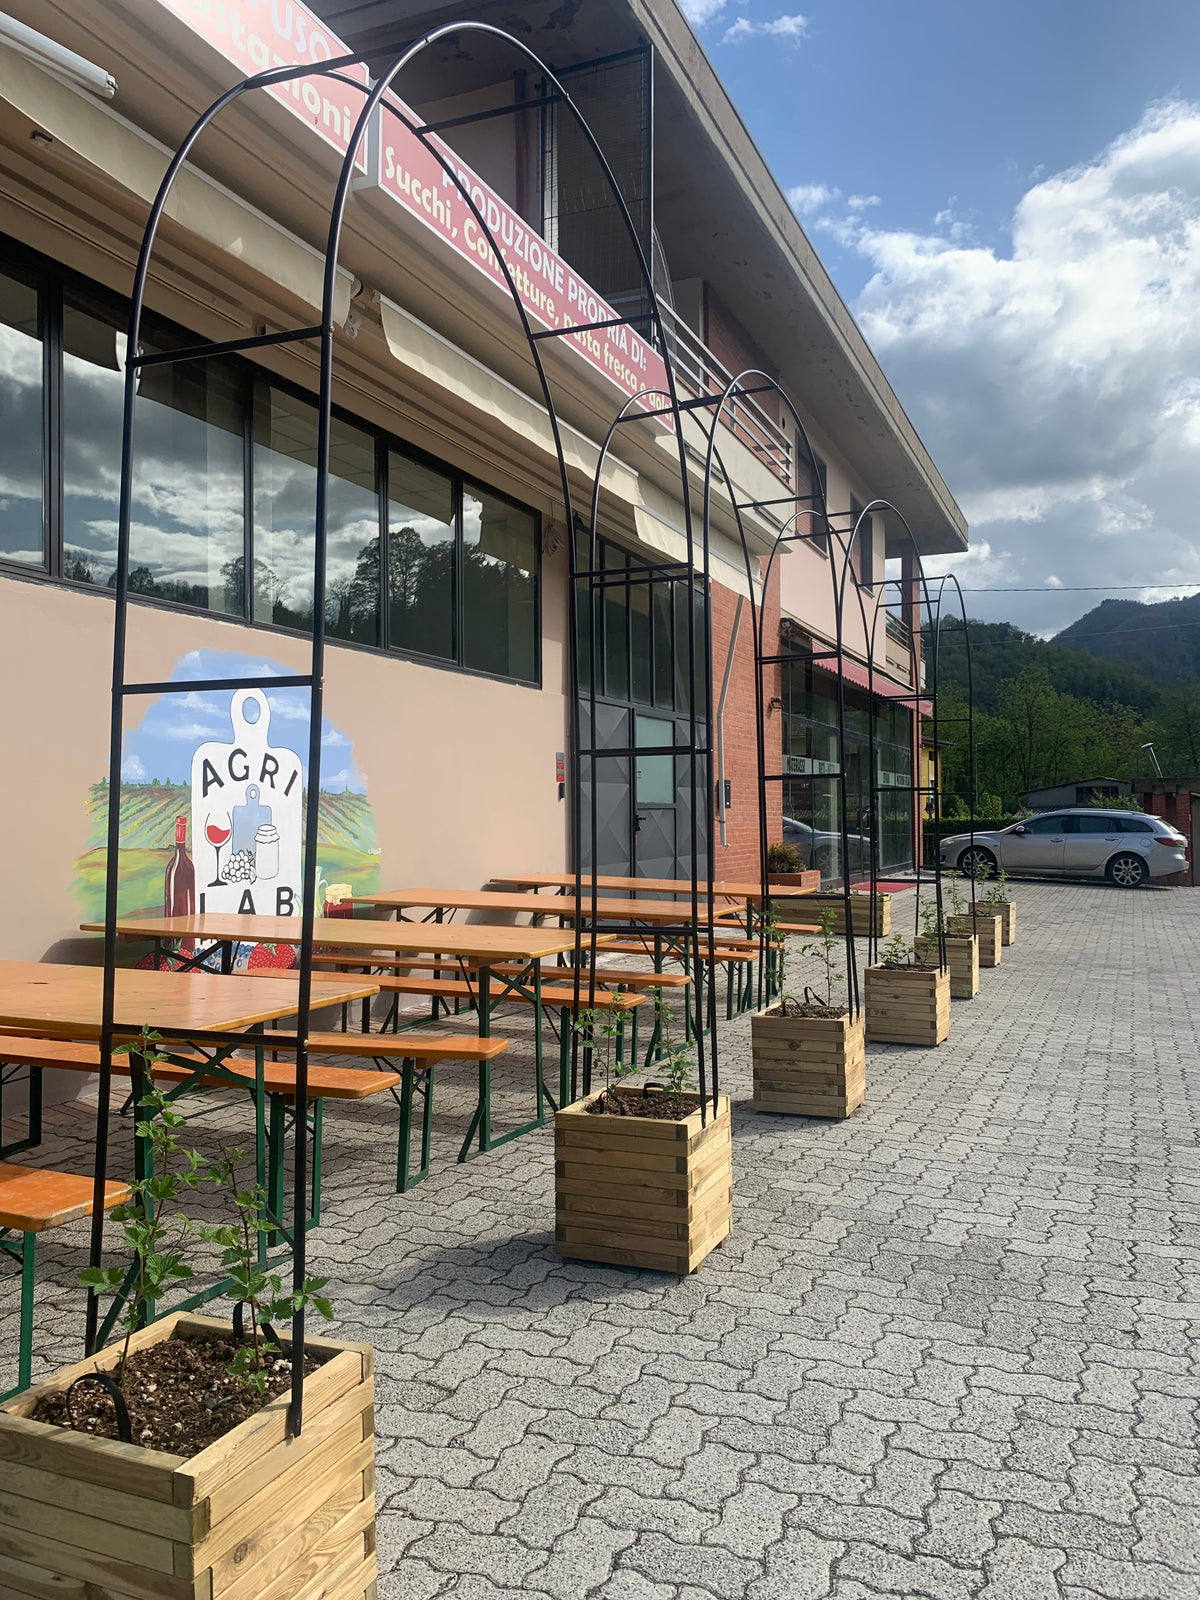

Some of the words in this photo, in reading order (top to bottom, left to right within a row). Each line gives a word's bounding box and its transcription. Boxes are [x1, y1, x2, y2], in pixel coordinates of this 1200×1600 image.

[385, 145, 458, 239] Succhi,
[603, 342, 638, 393] fresca
[442, 154, 565, 295] PRODUZIONE
[631, 336, 648, 372] DI:
[202, 748, 298, 799] AGRI
